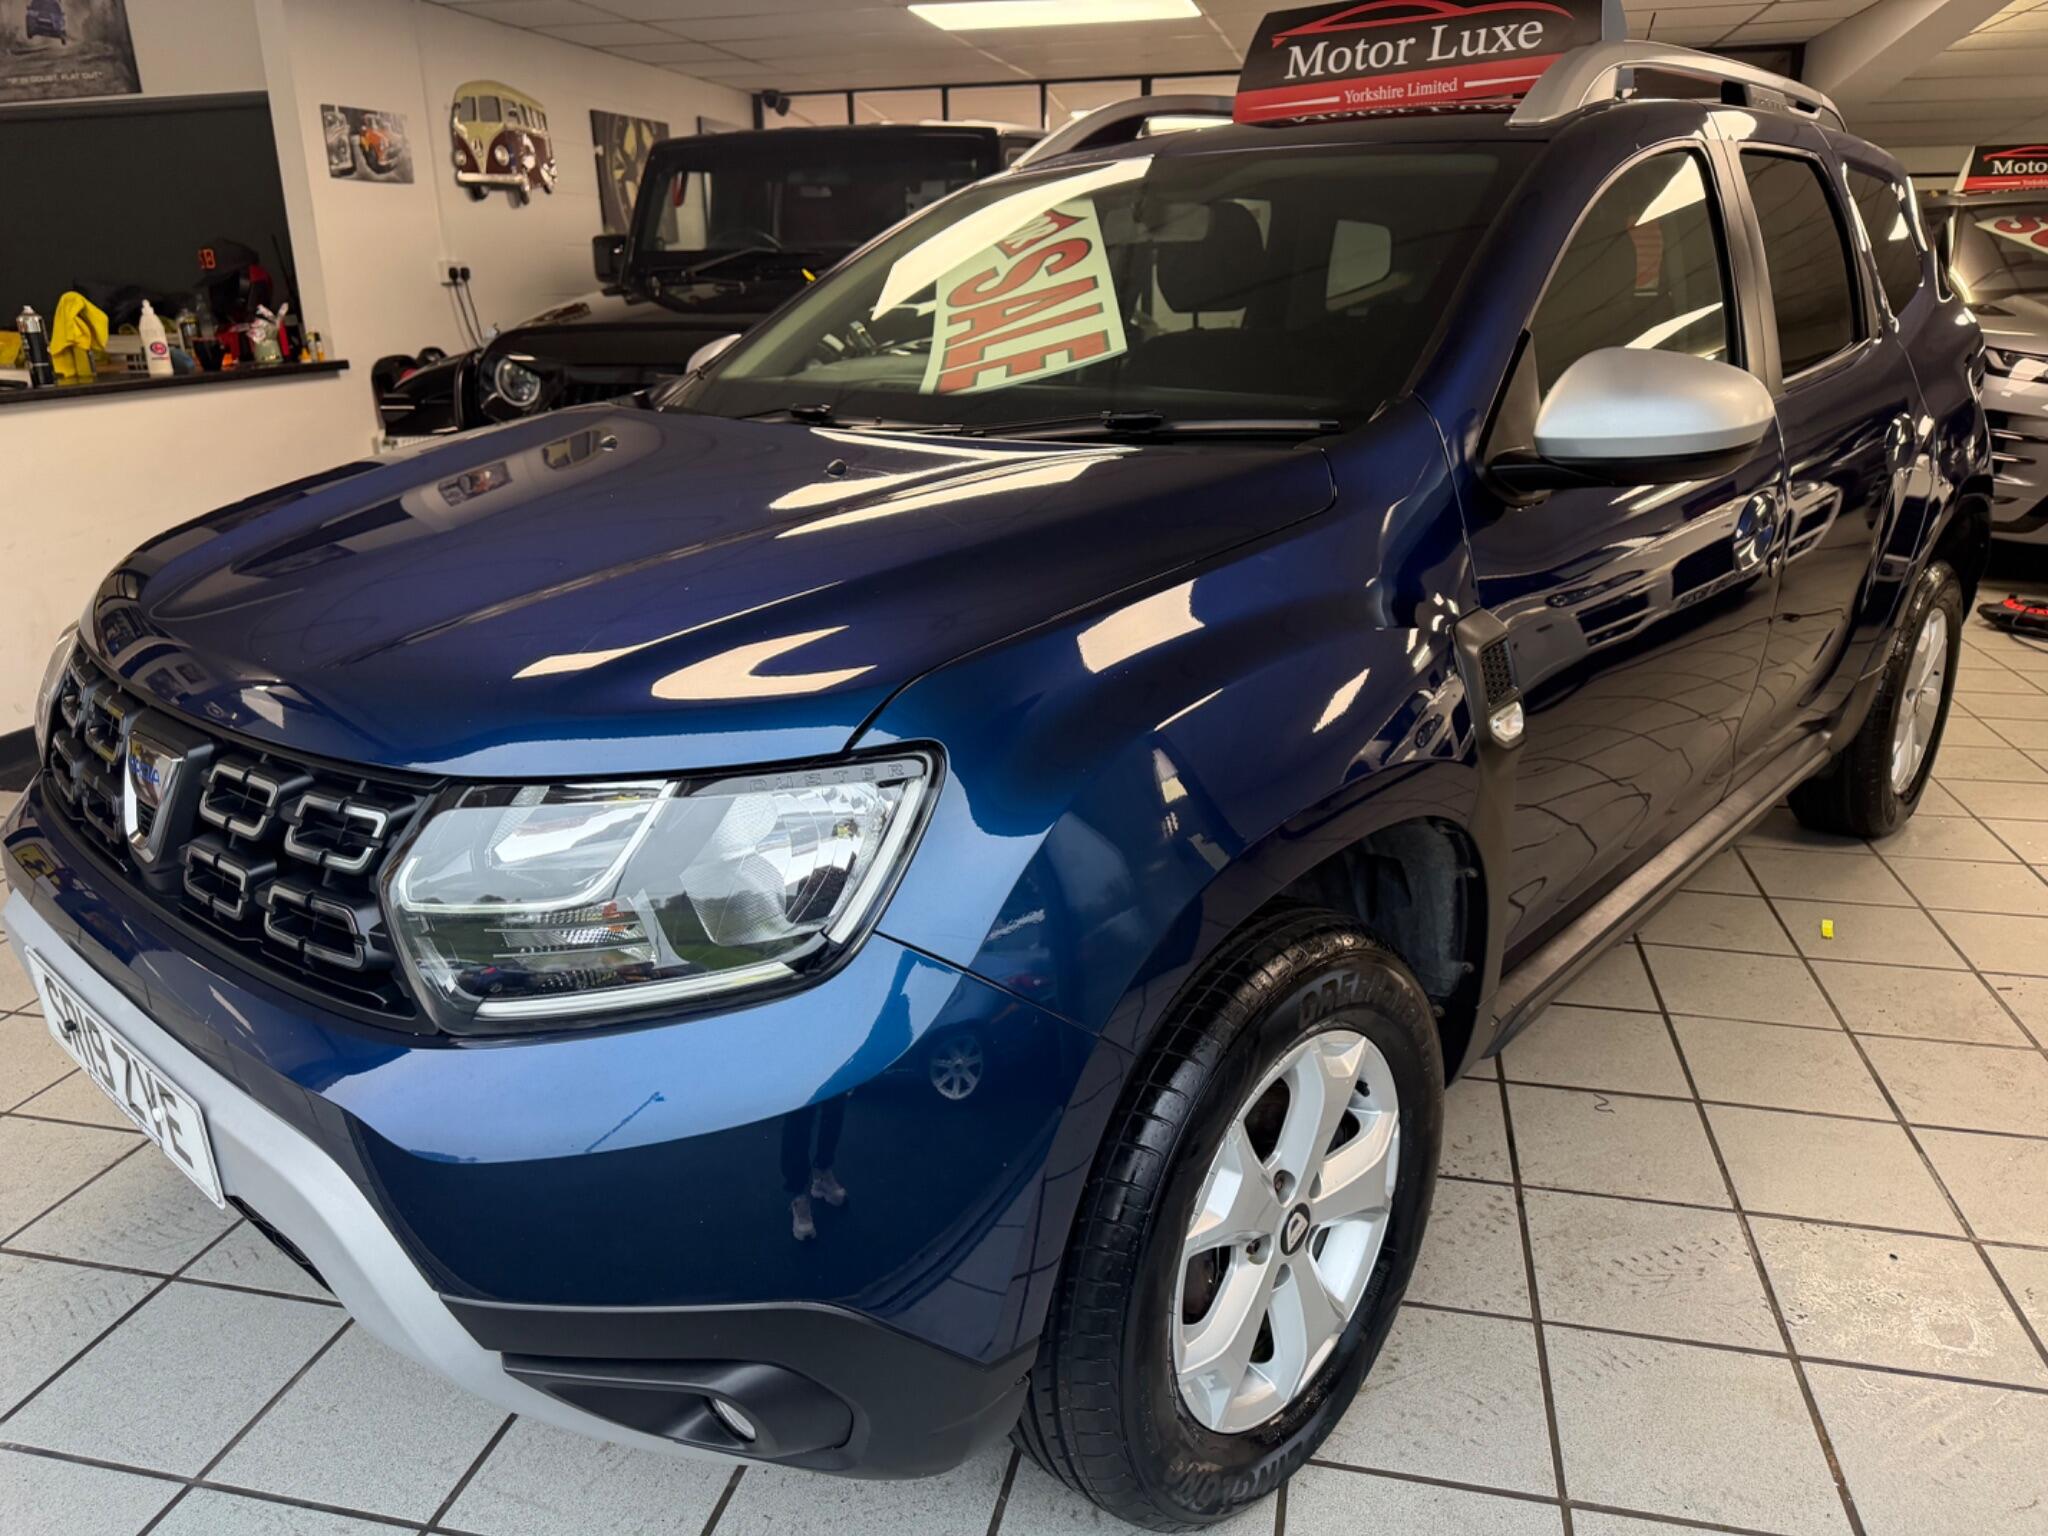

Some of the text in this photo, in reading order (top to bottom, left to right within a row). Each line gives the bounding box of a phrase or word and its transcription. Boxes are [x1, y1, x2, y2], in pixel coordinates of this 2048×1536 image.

[1284, 18, 1544, 80] Motor Luxe
[1344, 78, 1458, 104] Yorkshire Limited
[936, 237, 1111, 393] SALE
[750, 764, 904, 791] DUSTER
[111, 1038, 194, 1169] ZVE
